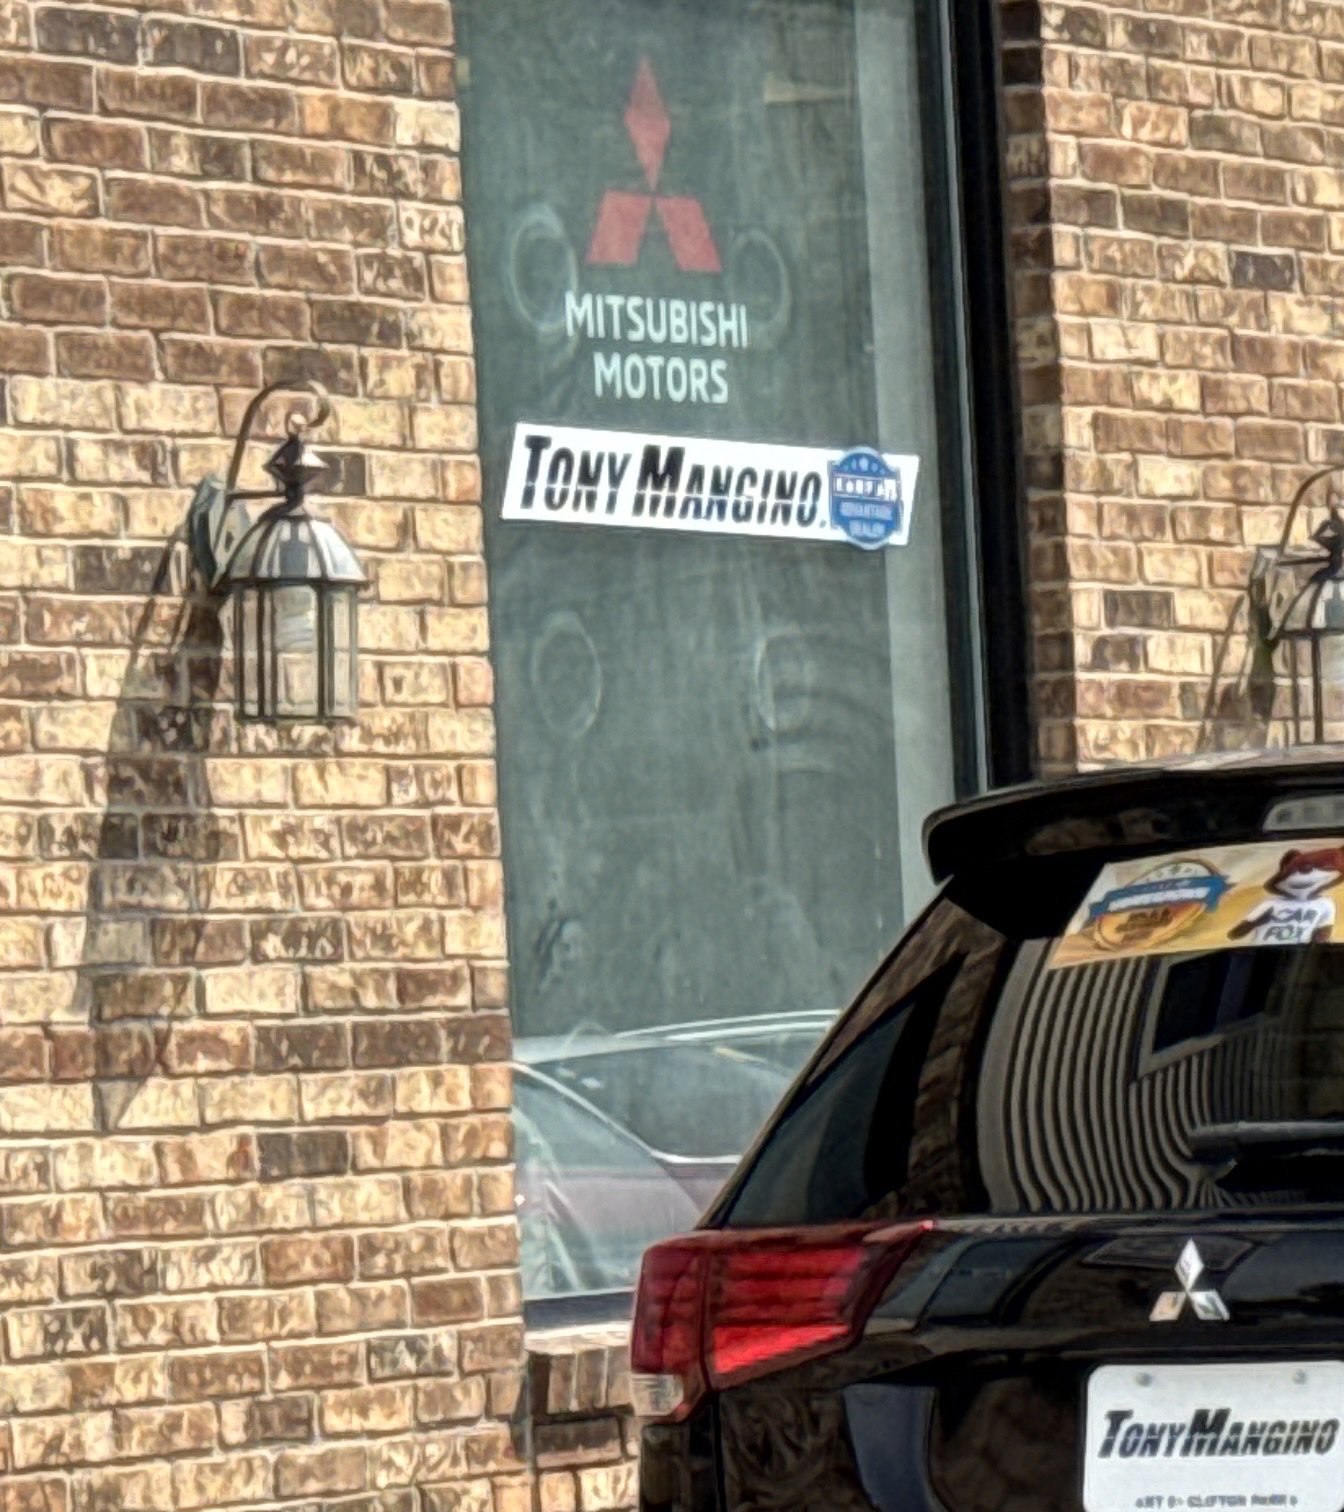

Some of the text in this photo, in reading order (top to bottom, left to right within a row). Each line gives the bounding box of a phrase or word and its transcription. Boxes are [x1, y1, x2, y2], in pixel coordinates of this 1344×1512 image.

[564, 289, 749, 349] MITSUBISHI
[593, 351, 729, 404] MOTORS
[519, 434, 633, 515] TONY
